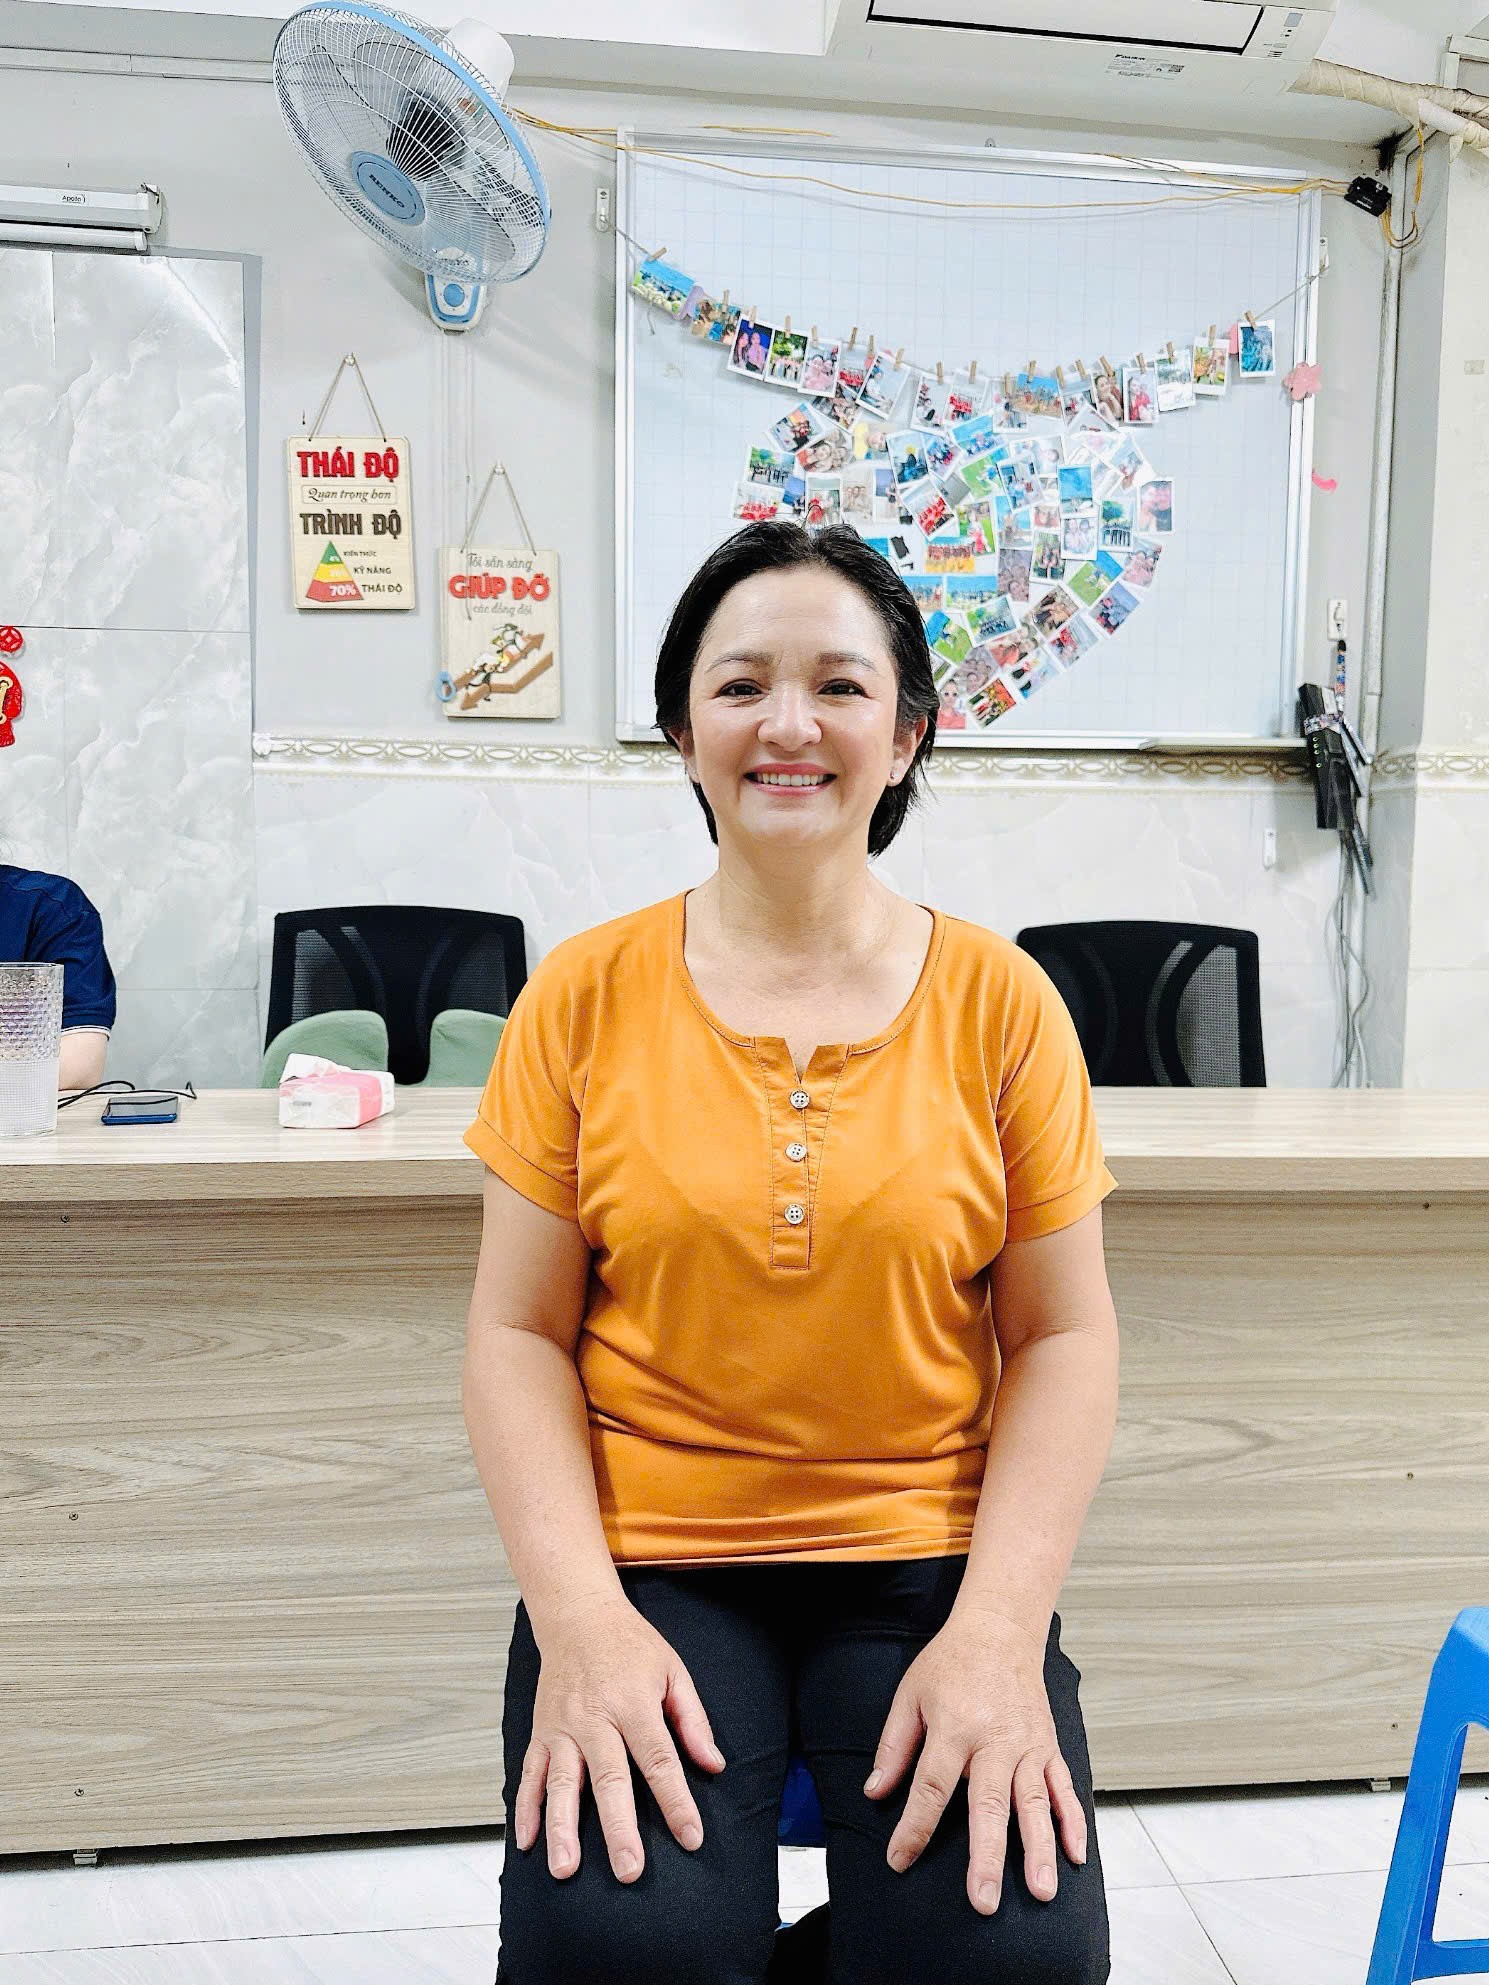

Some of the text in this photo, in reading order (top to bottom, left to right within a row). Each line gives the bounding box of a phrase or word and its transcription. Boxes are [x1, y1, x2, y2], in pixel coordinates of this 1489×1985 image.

[296, 446, 399, 482] THÁI ĐỘ
[308, 487, 337, 503] Quan
[340, 489, 369, 503] trọng
[299, 508, 402, 540] TRÌNH ĐỘ
[506, 557, 534, 573] sàng
[329, 584, 356, 597] 70%
[361, 583, 386, 593] THÁI
[449, 572, 506, 600] GIÚP
